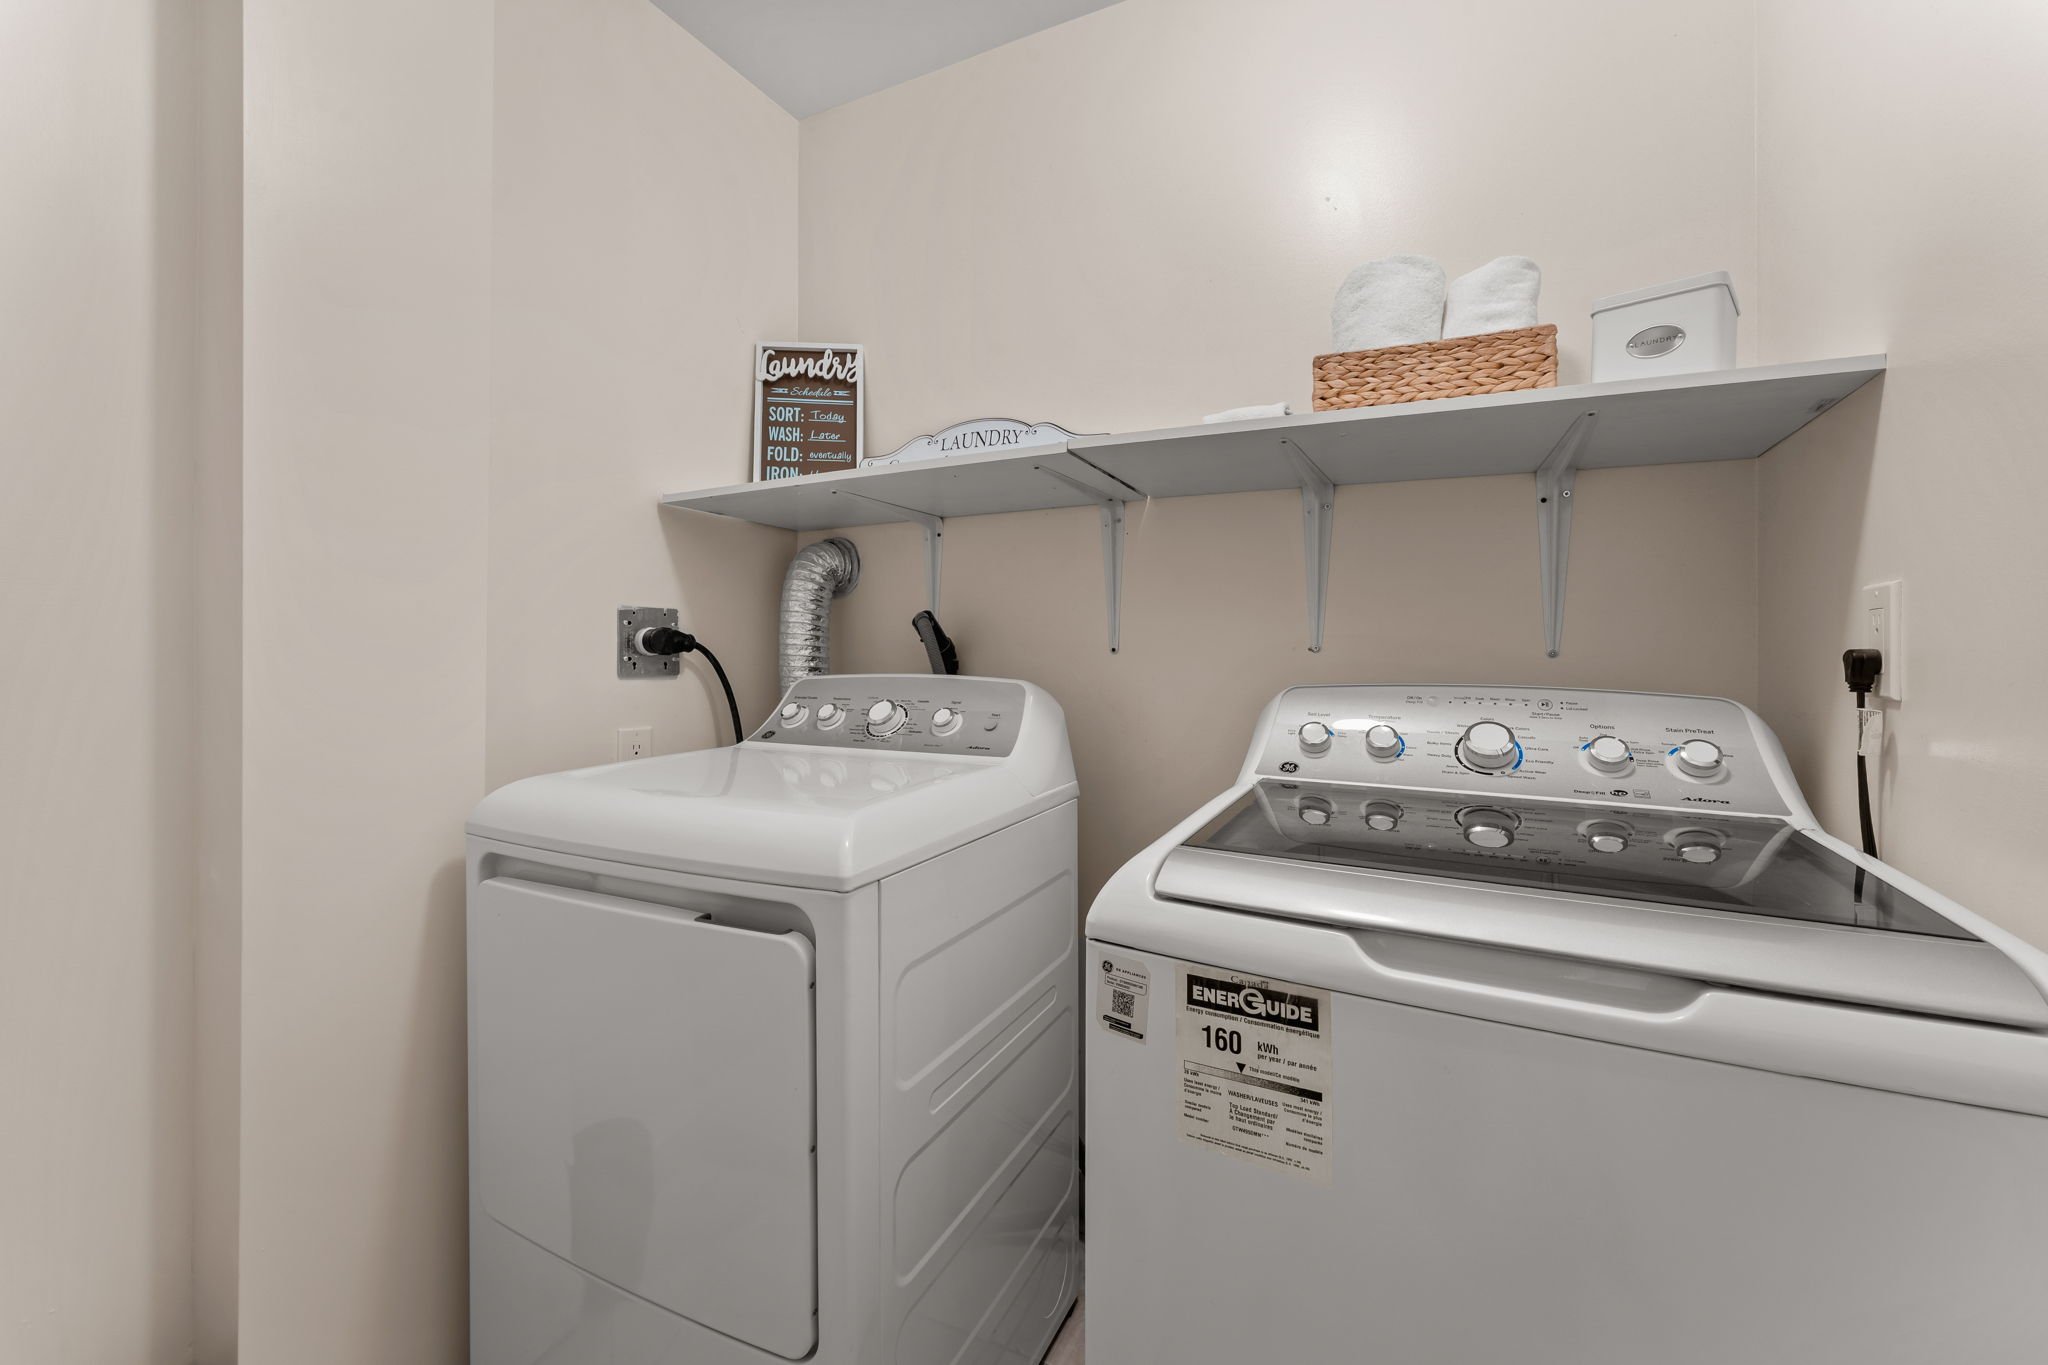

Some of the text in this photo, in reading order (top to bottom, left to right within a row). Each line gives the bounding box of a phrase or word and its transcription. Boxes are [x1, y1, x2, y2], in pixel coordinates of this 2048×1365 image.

[760, 348, 858, 383] Laundry
[790, 386, 833, 398] Schedule
[768, 406, 845, 424] SORT: Today
[768, 426, 841, 442] WASH: Later
[940, 429, 1024, 451] LAUNDRY
[767, 446, 852, 463] FOLD: eventually
[1192, 984, 1313, 1024] ENERGUIDE
[1186, 1005, 1204, 1015] Energy
[1205, 1010, 1239, 1023] consumption
[1243, 1018, 1285, 1032] Consommation
[1202, 1025, 1242, 1055] 160
[1257, 1041, 1279, 1056] kWh
[1257, 1053, 1267, 1061] per
[1268, 1056, 1282, 1064] year
[1287, 1060, 1298, 1068] par
[1299, 1062, 1318, 1072] année
[1228, 1089, 1279, 1107] WASHER/LAVEUSES
[1229, 1102, 1238, 1110] Top
[1240, 1104, 1252, 1112] Load
